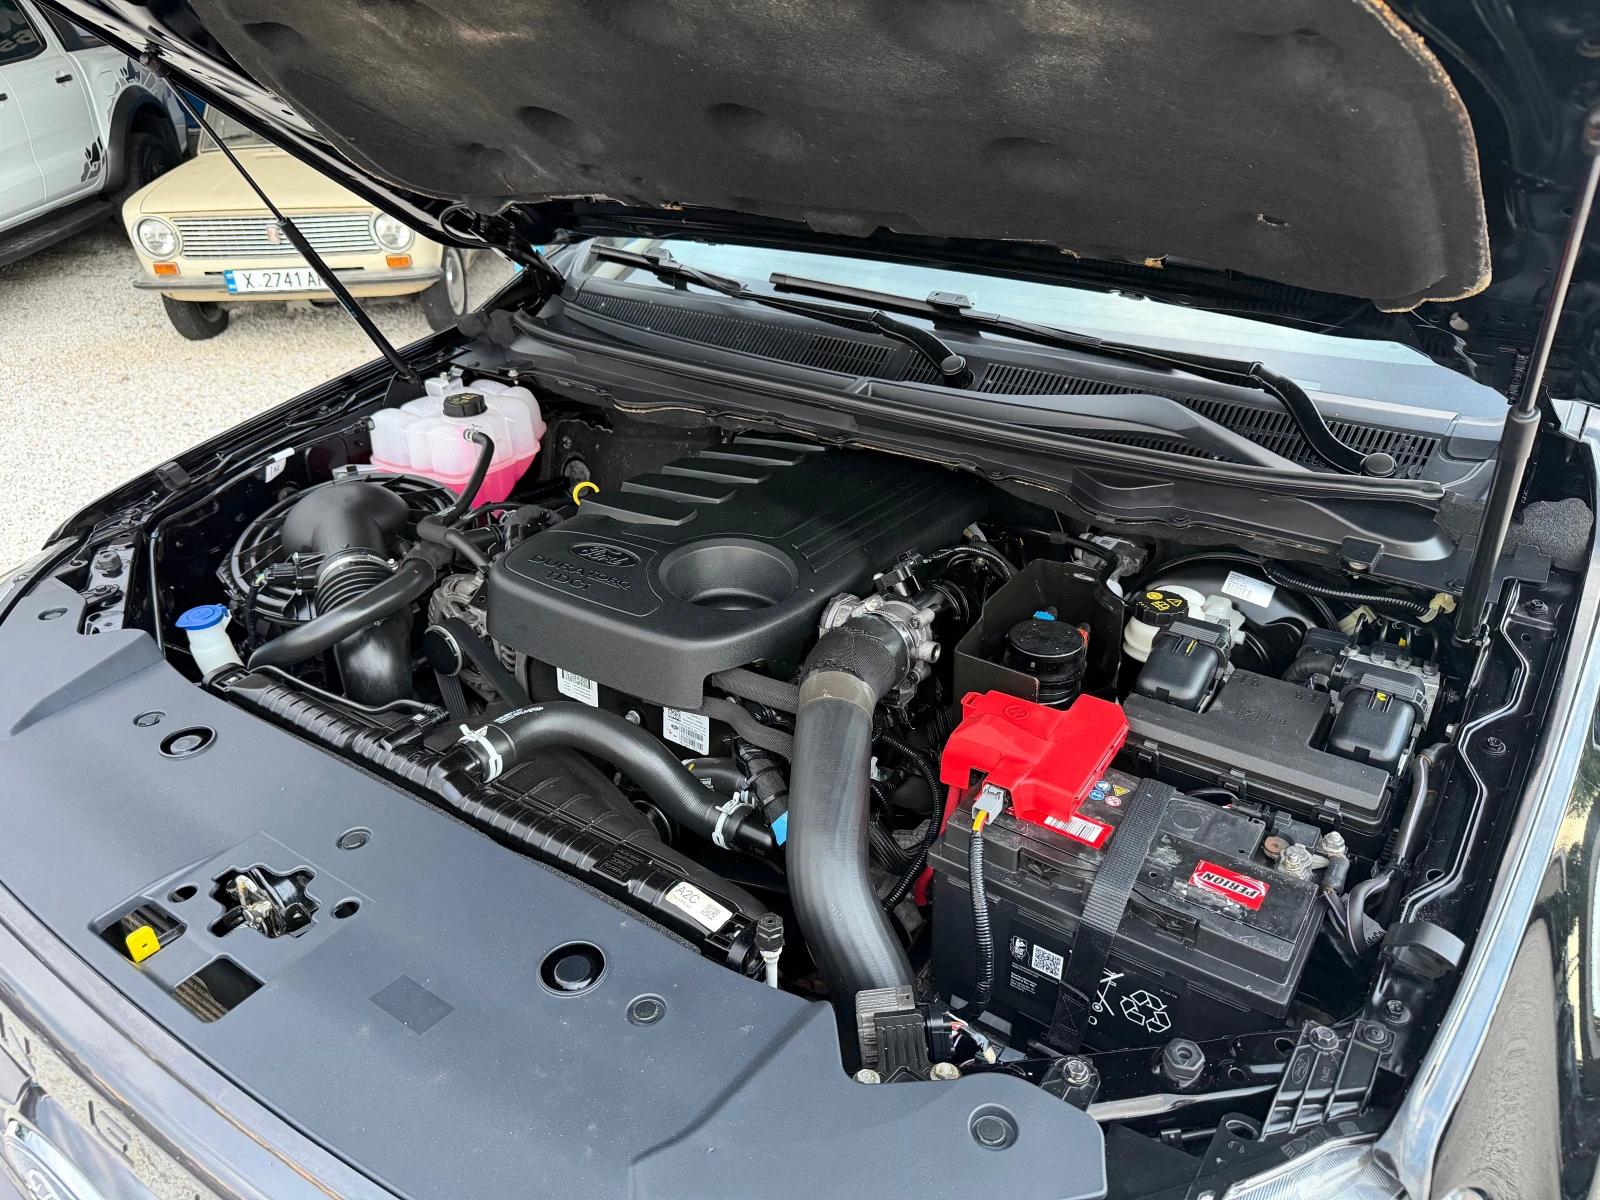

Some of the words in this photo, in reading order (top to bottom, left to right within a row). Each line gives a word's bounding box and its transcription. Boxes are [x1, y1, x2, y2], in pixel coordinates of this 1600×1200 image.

[243, 273, 255, 289] X
[262, 271, 302, 288] 2741
[577, 544, 630, 566] Ford
[675, 882, 701, 906] A2C
[1202, 871, 1258, 898] PERION
